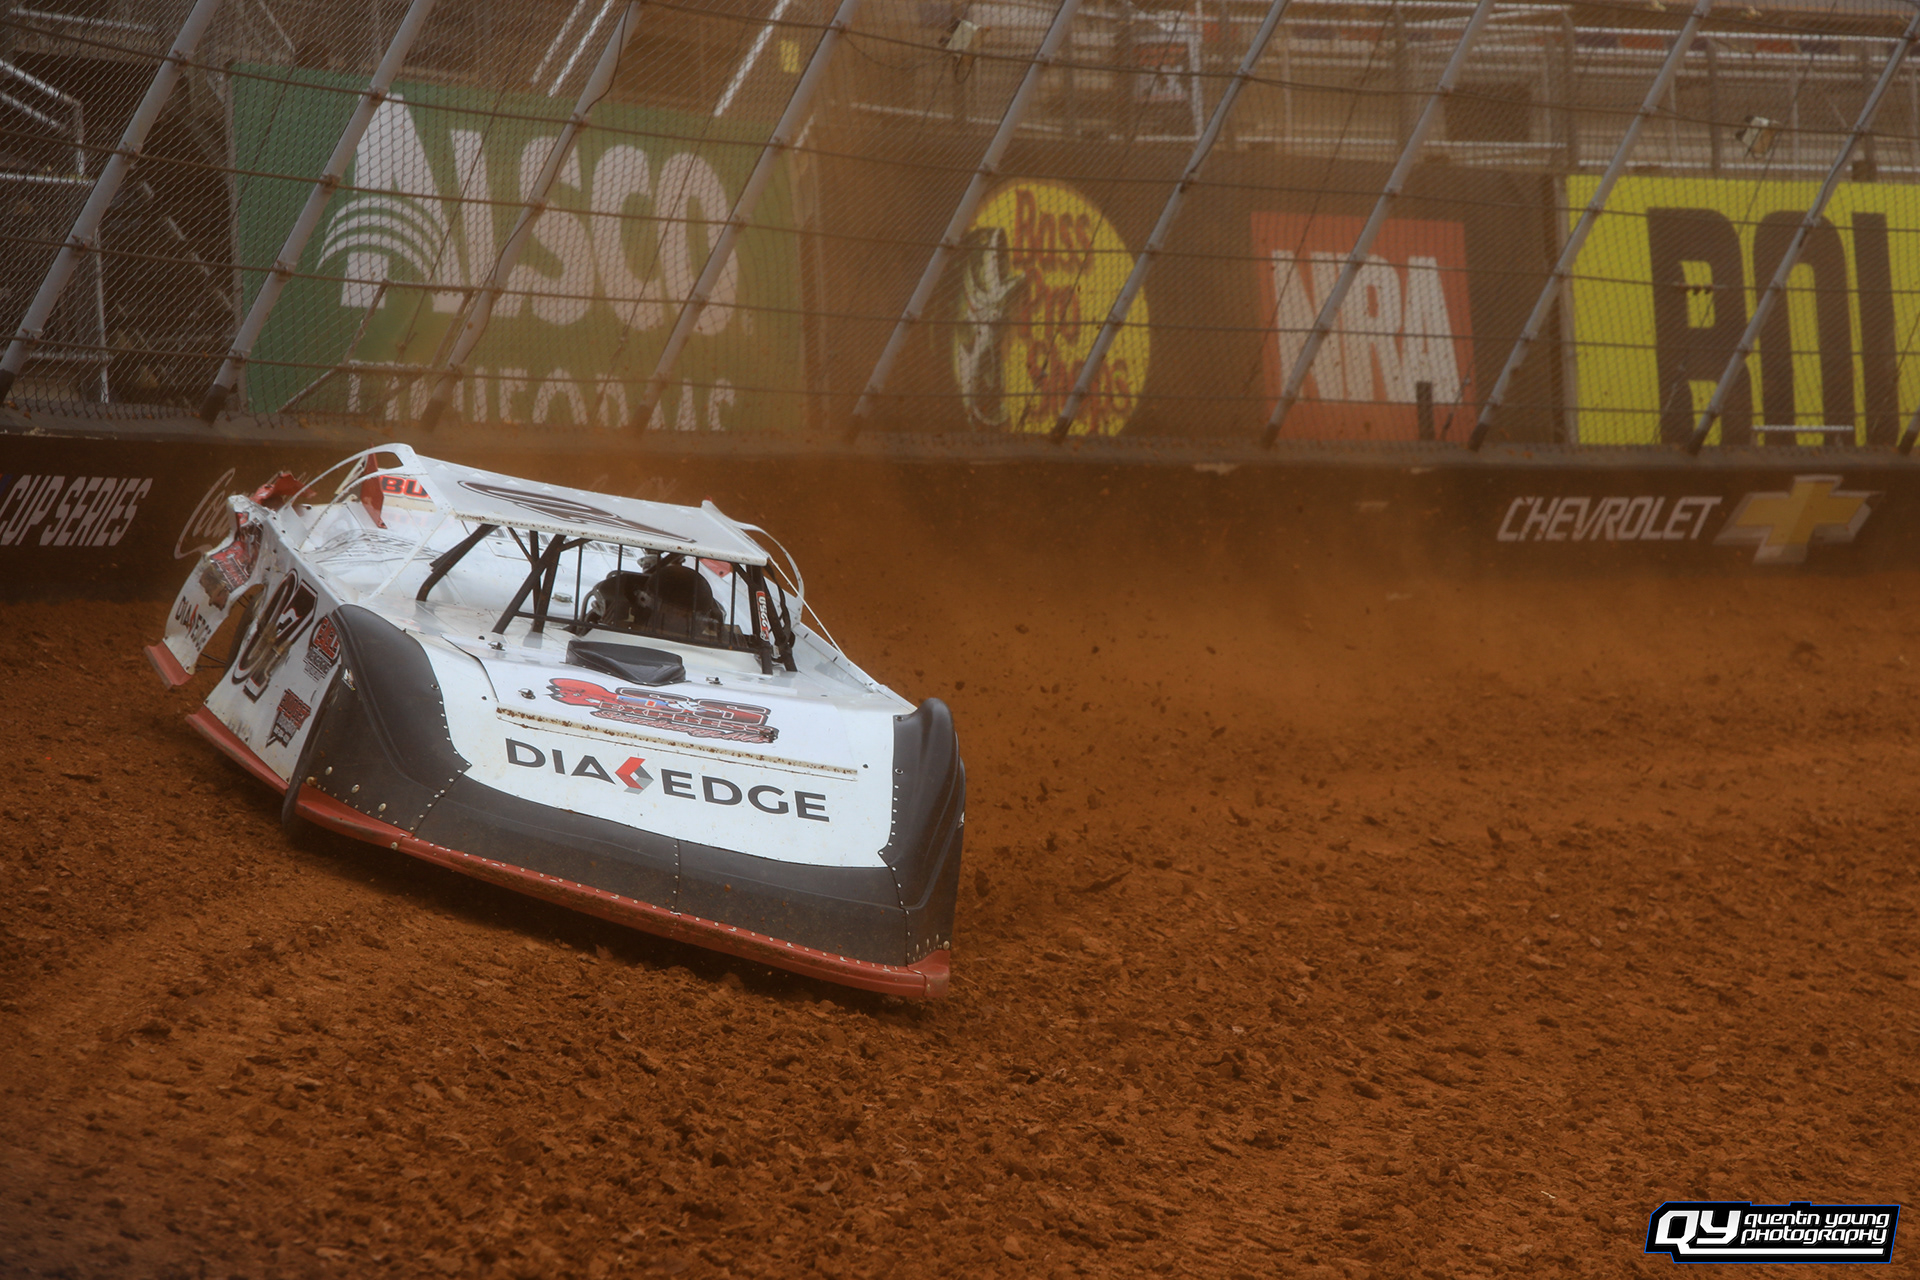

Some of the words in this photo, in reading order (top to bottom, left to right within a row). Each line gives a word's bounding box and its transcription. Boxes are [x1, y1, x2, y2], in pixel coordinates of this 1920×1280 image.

[1012, 188, 1097, 275] Bass
[1271, 249, 1464, 404] NRA
[0, 474, 65, 546] CUP
[39, 475, 153, 546] SERIES
[1497, 497, 1723, 541] CHEVROLET
